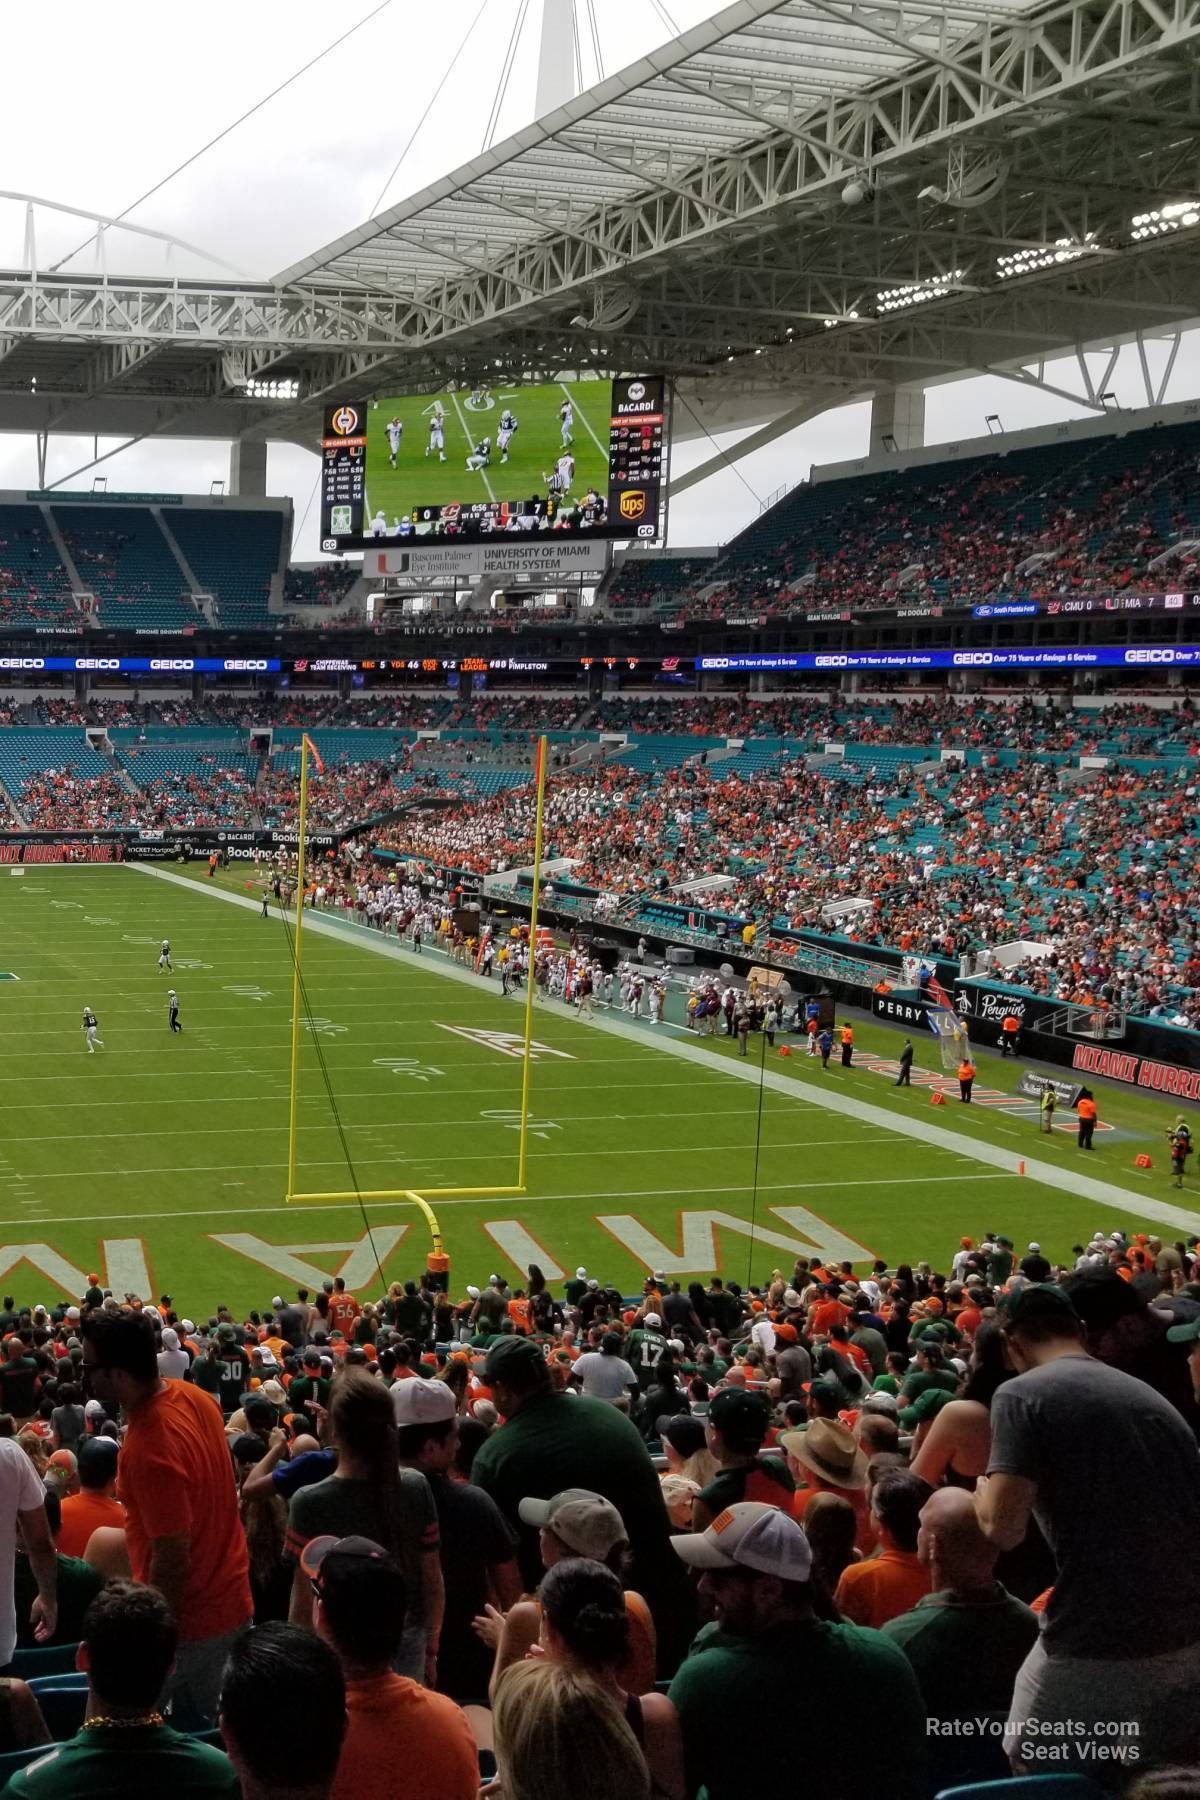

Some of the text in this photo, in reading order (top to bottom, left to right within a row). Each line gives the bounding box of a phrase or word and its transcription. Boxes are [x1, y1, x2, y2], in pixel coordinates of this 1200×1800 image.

[622, 499, 643, 512] ups
[423, 509, 431, 519] 0
[534, 504, 540, 514] 7
[639, 527, 653, 536] CC
[324, 541, 335, 549] CC
[411, 551, 472, 561] Bascom Palmer
[484, 546, 590, 559] UNIVERSITY OF MIAMI
[411, 562, 460, 572] Eye Institute
[484, 559, 560, 571] HEALTH SYSTEM
[1065, 598, 1154, 611] CMU 0 MIA 7
[447, 626, 493, 635] HONOR
[953, 653, 993, 664] GEICO
[1018, 654, 1034, 662] Years
[1043, 654, 1066, 663] Savings
[1073, 653, 1097, 661] Service
[1125, 649, 1174, 662] GEICO
[0, 658, 45, 668] GEICO
[75, 659, 120, 669] GEICO
[150, 659, 194, 669] GEICO
[224, 659, 267, 670] GEICO
[380, 661, 386, 669] 5
[407, 660, 419, 668] 46
[442, 660, 456, 669] 9.2
[702, 658, 728, 668] GEICO
[815, 656, 847, 666] GEICO
[460, 664, 488, 672] LEADER
[878, 1000, 922, 1020] PERRY
[1072, 1044, 1139, 1082] MIAMI
[336, 1303, 353, 1319] 56
[640, 1342, 664, 1367] 17
